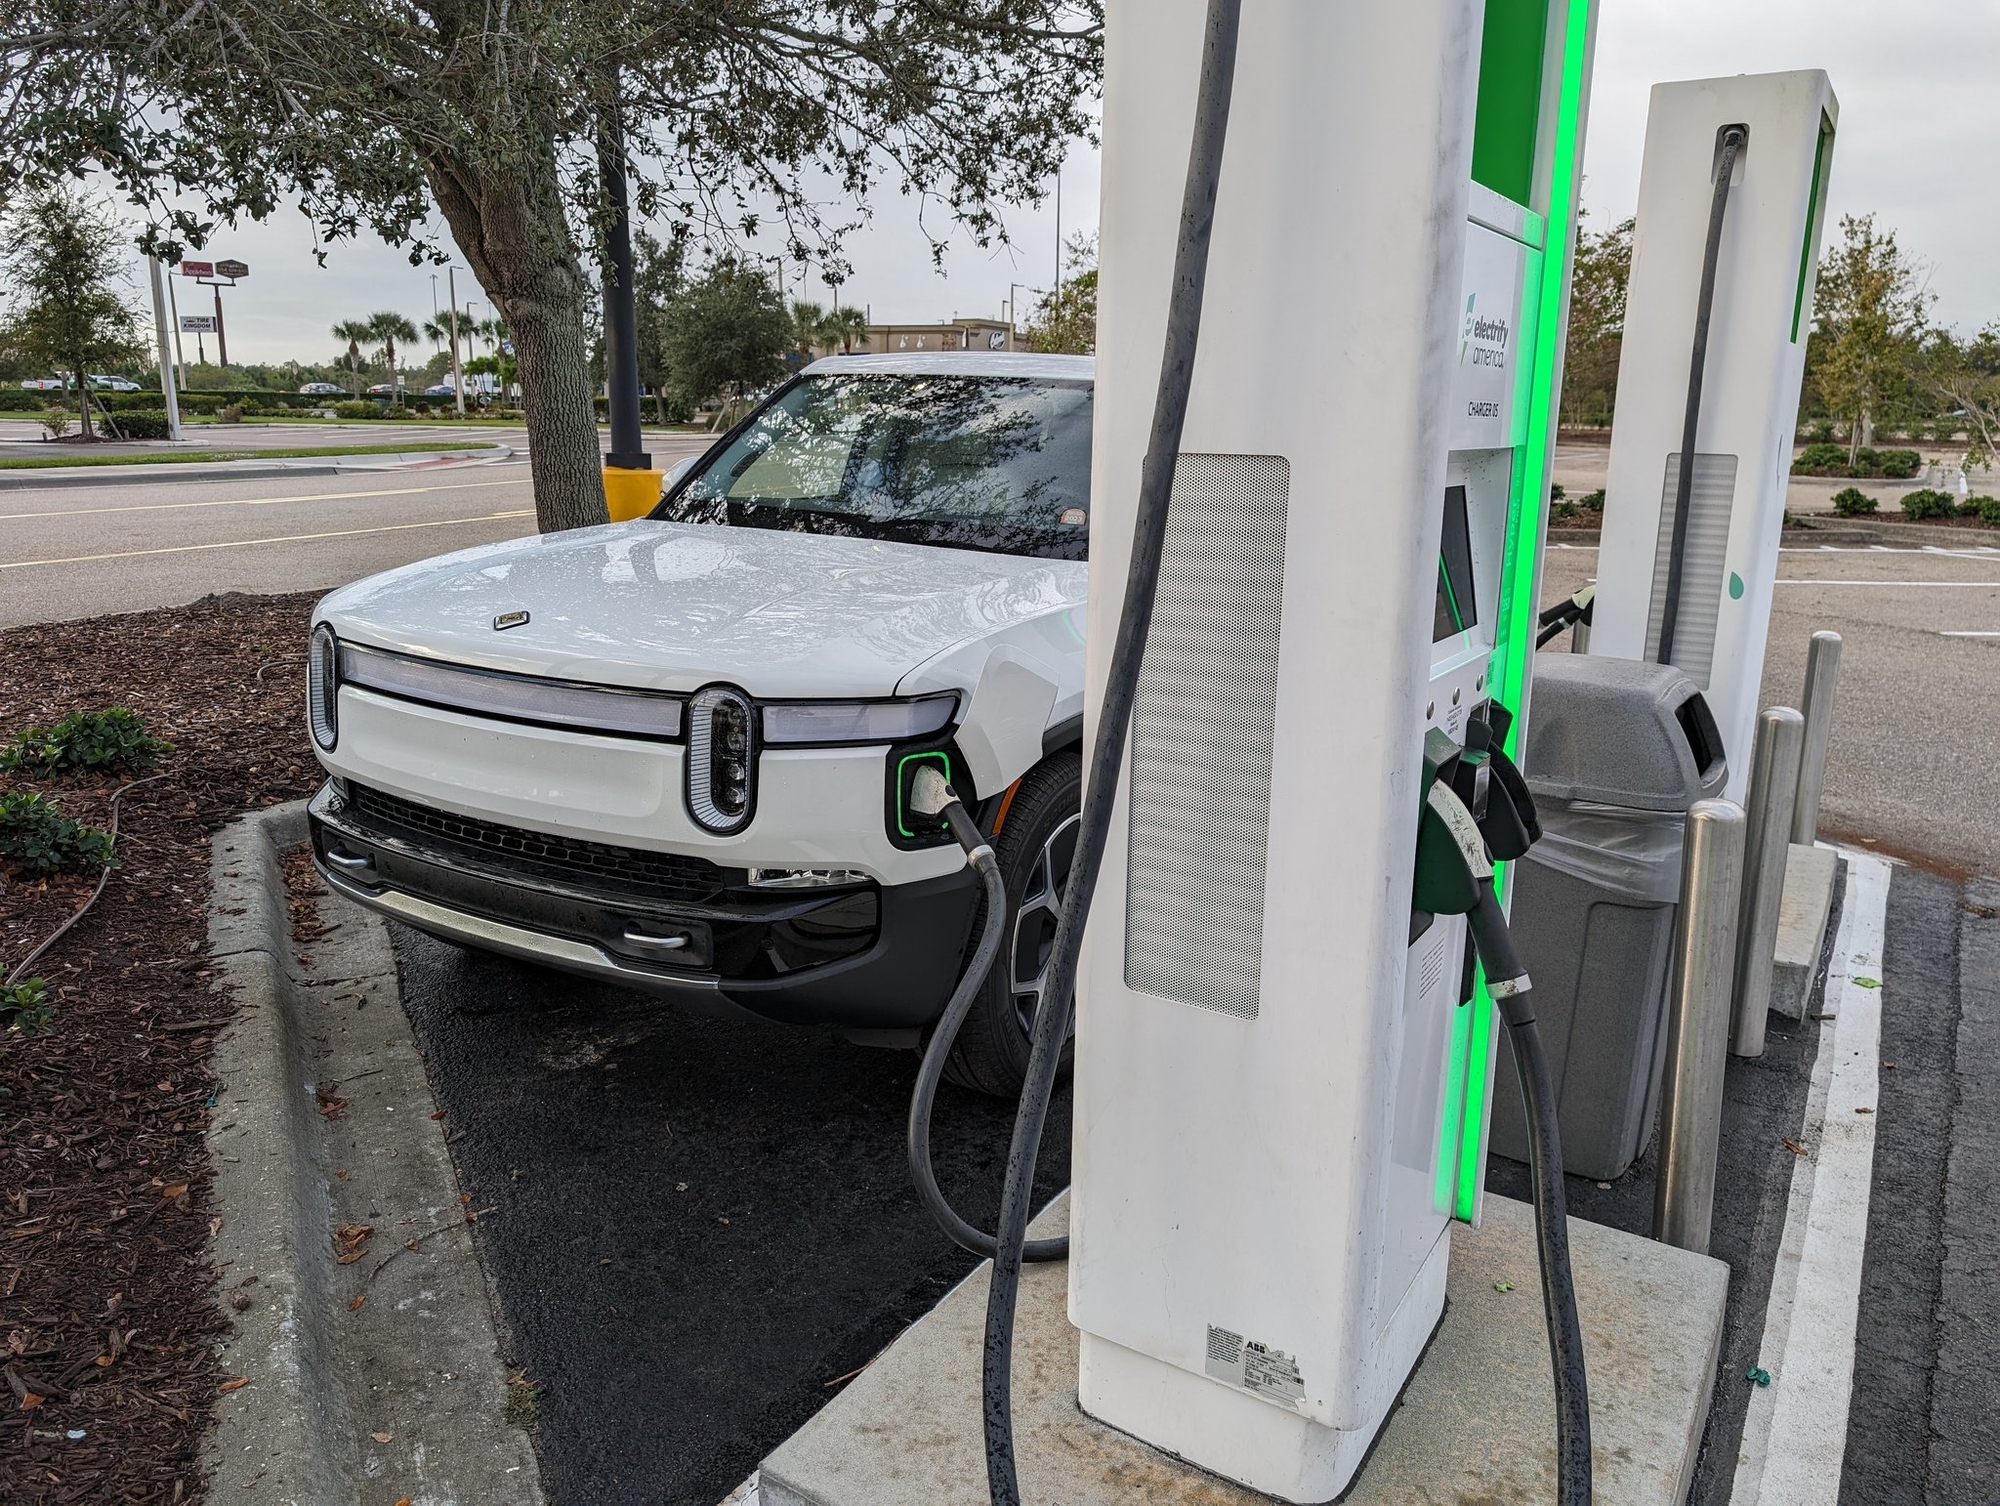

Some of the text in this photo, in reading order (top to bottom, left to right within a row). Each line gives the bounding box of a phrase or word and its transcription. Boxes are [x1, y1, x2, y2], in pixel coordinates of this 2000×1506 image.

[1474, 314, 1509, 349] electrify
[1468, 401, 1492, 417] CHARGER
[1246, 1341, 1266, 1354] ABB
